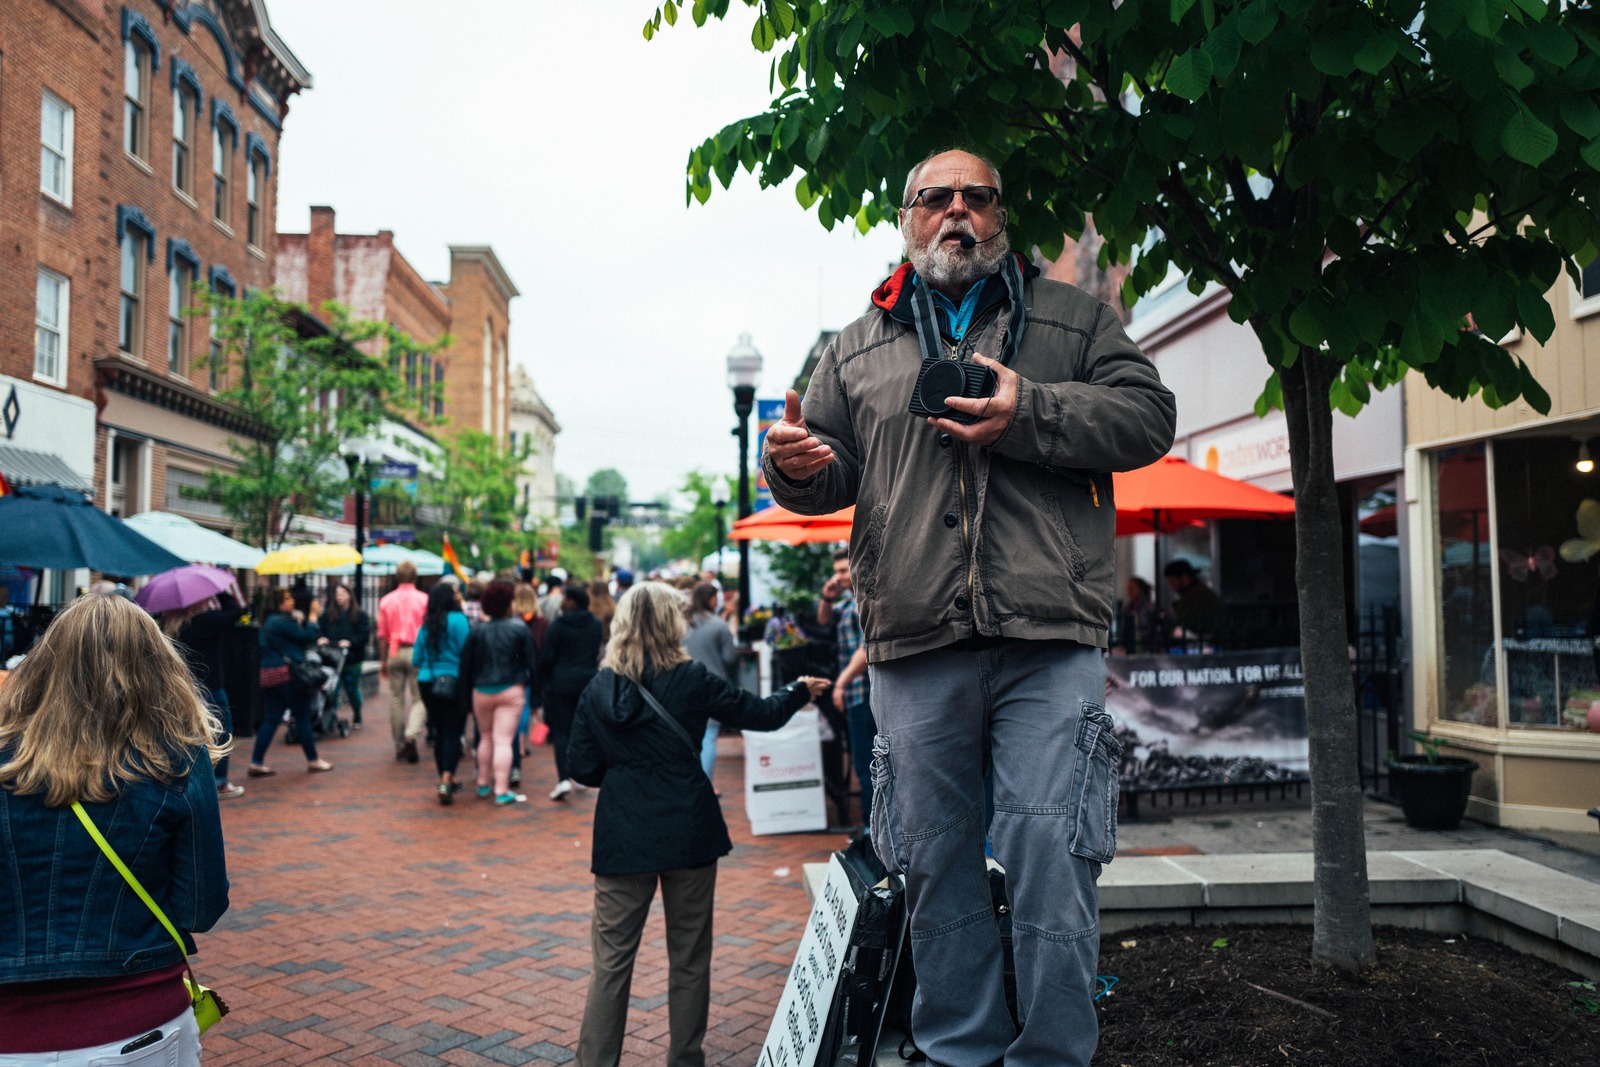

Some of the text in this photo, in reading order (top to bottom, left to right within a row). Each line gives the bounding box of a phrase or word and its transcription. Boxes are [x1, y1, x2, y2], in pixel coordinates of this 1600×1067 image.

[1130, 670, 1157, 689] FOR
[1159, 669, 1186, 687] OUR
[1236, 665, 1262, 684] FOR
[1264, 664, 1281, 681] US
[829, 886, 839, 916] Are
[836, 897, 847, 938] Made
[786, 1000, 806, 1067] Reflected
[806, 992, 819, 1043] Image
[775, 1036, 784, 1064] In
